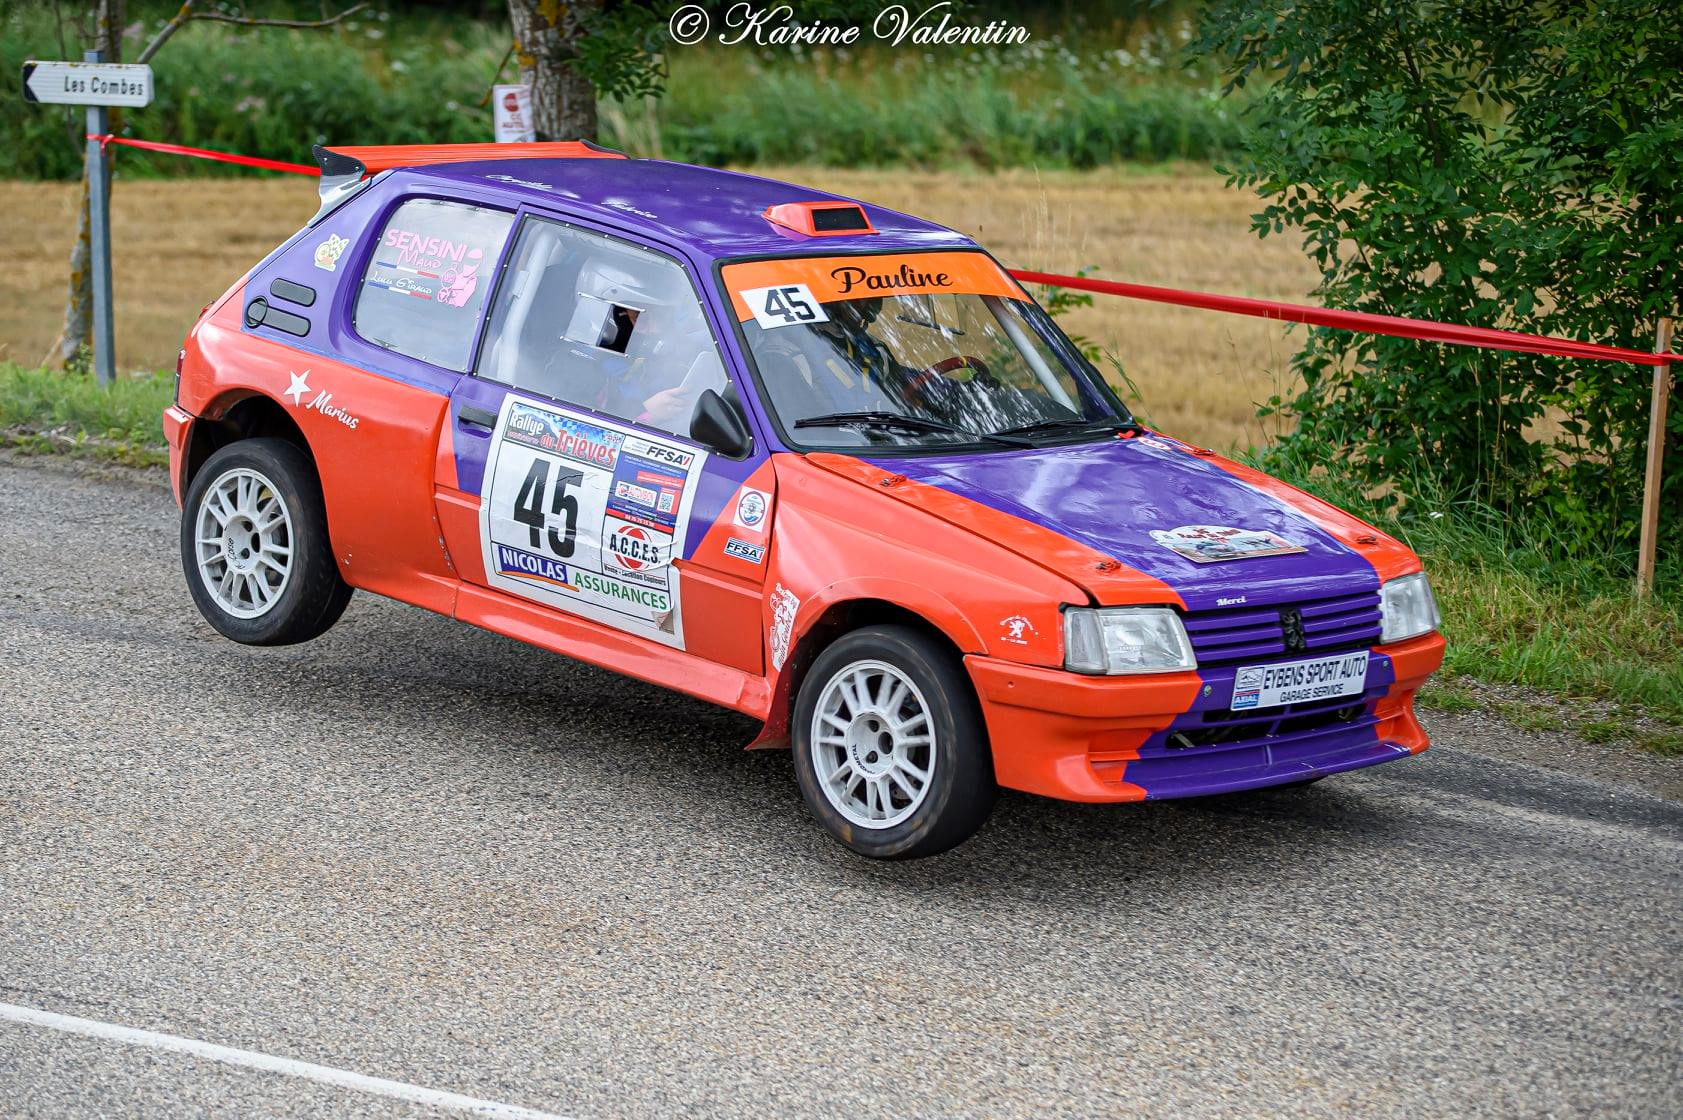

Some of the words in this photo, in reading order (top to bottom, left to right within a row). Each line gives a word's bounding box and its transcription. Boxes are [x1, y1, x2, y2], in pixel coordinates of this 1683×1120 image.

[64, 75, 85, 93] Les
[90, 76, 144, 96] Combes
[384, 228, 468, 263] SENSINI
[831, 264, 953, 294] Pauline
[763, 287, 816, 323] 45
[305, 389, 359, 429] Marius
[509, 411, 545, 436] Rallye
[540, 432, 553, 449] du
[646, 445, 685, 466] FFSA
[513, 457, 585, 558] 45
[502, 547, 567, 582] NICOLAS
[726, 542, 759, 558] FFSA
[574, 572, 668, 611] ASSURANCES
[1216, 596, 1247, 607] Merci
[1263, 664, 1304, 690] EYBENS
[1305, 659, 1340, 685] SPORT
[1340, 655, 1367, 679] AUTO
[1280, 686, 1311, 703] GARAGE
[1312, 683, 1344, 700] SERVICE
